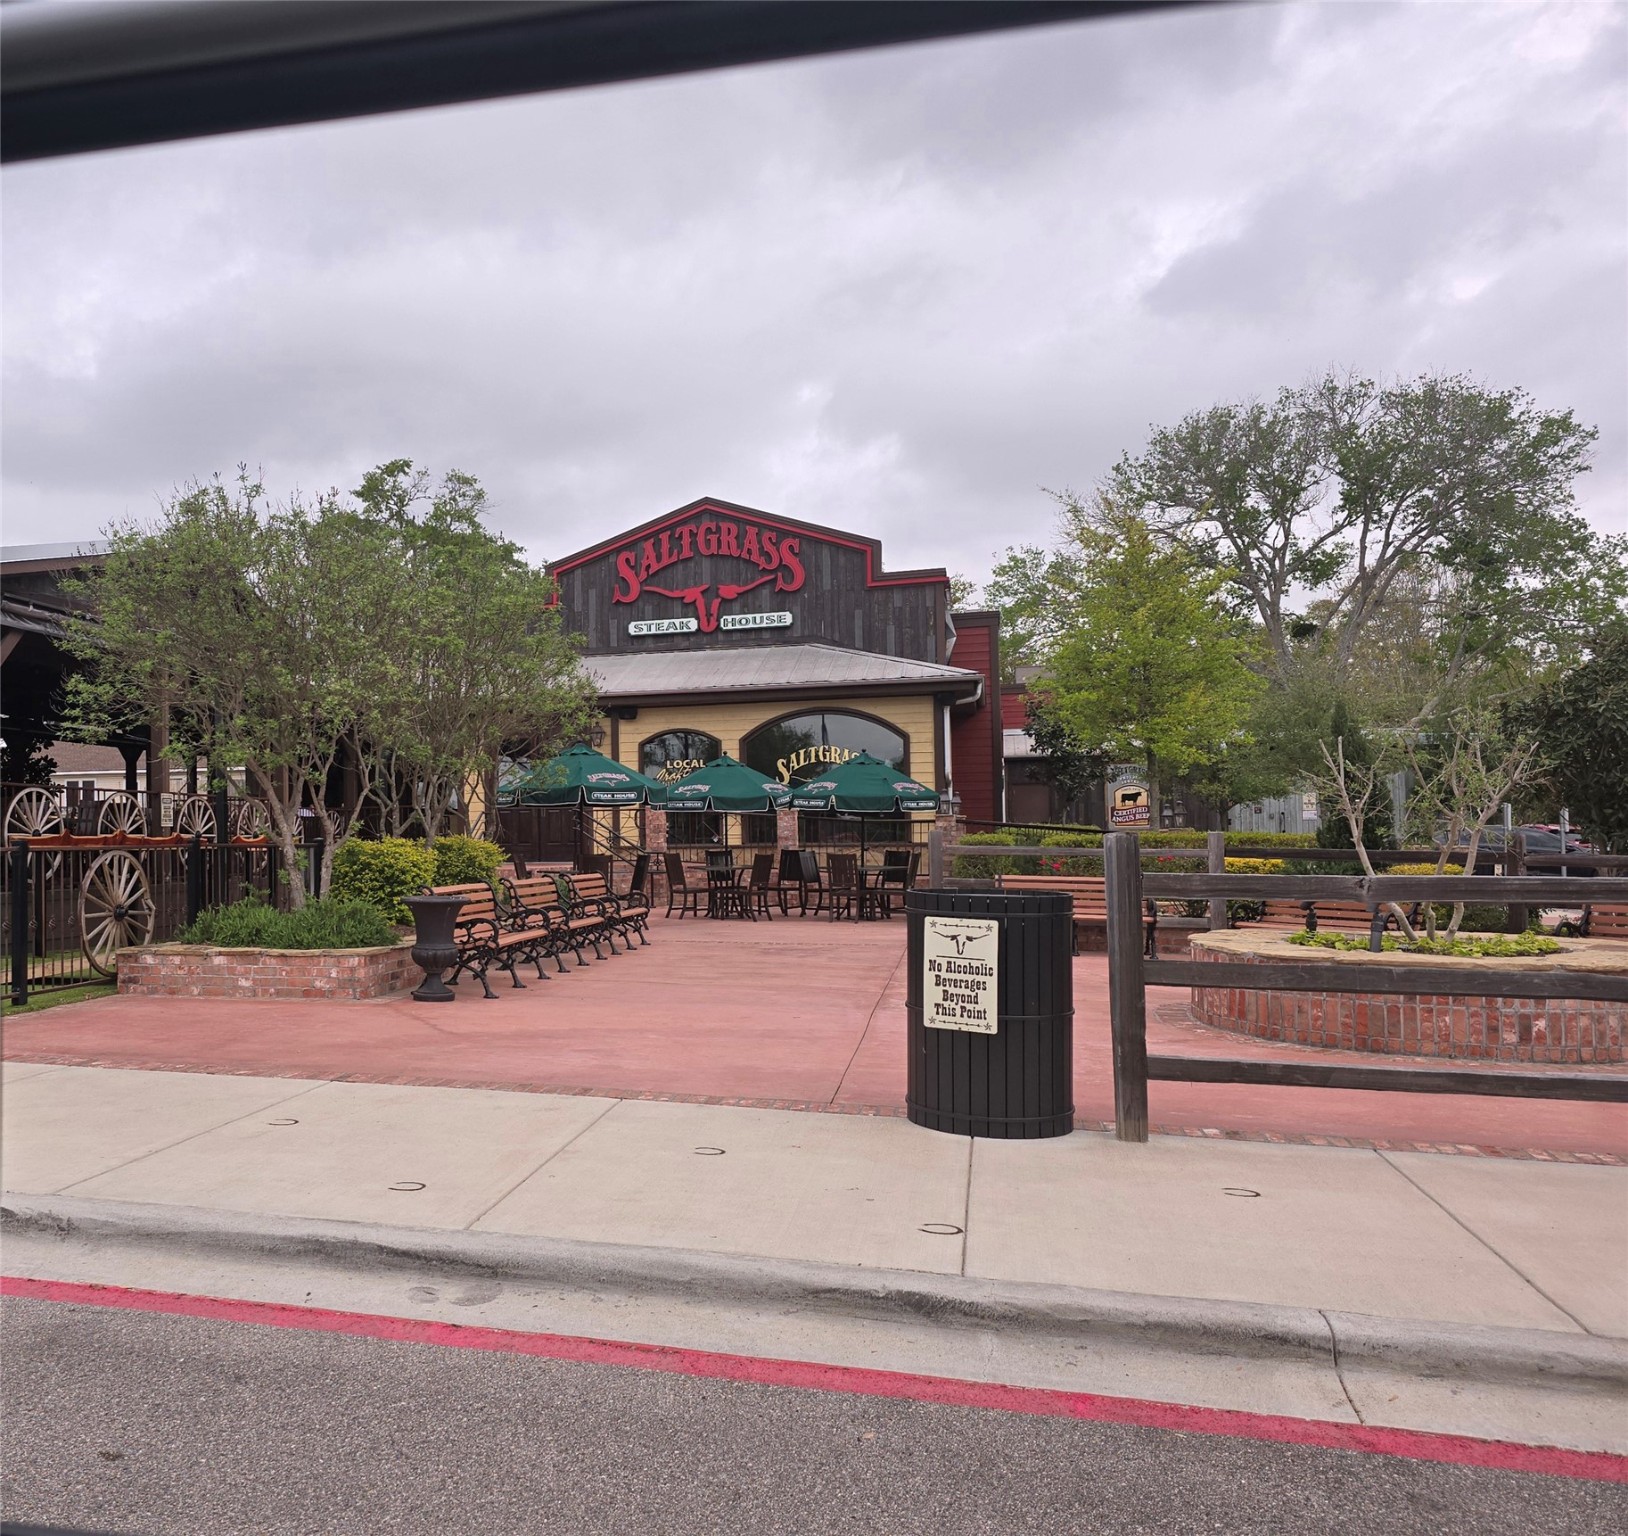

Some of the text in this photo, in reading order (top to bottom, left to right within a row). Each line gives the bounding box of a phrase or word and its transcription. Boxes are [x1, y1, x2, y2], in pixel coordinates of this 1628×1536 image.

[612, 521, 806, 604] SALTGRASS
[633, 613, 787, 633] STEAK HOUSE
[666, 759, 706, 769] LOCAL
[776, 745, 860, 786] SALTGRA
[1112, 814, 1135, 822] ANGUS
[1113, 807, 1148, 816] CERTIFIED
[928, 959, 994, 977] No Alcoholic
[934, 974, 987, 992] Beverages
[942, 989, 979, 1005] Beyond
[934, 1003, 987, 1020] This Point
